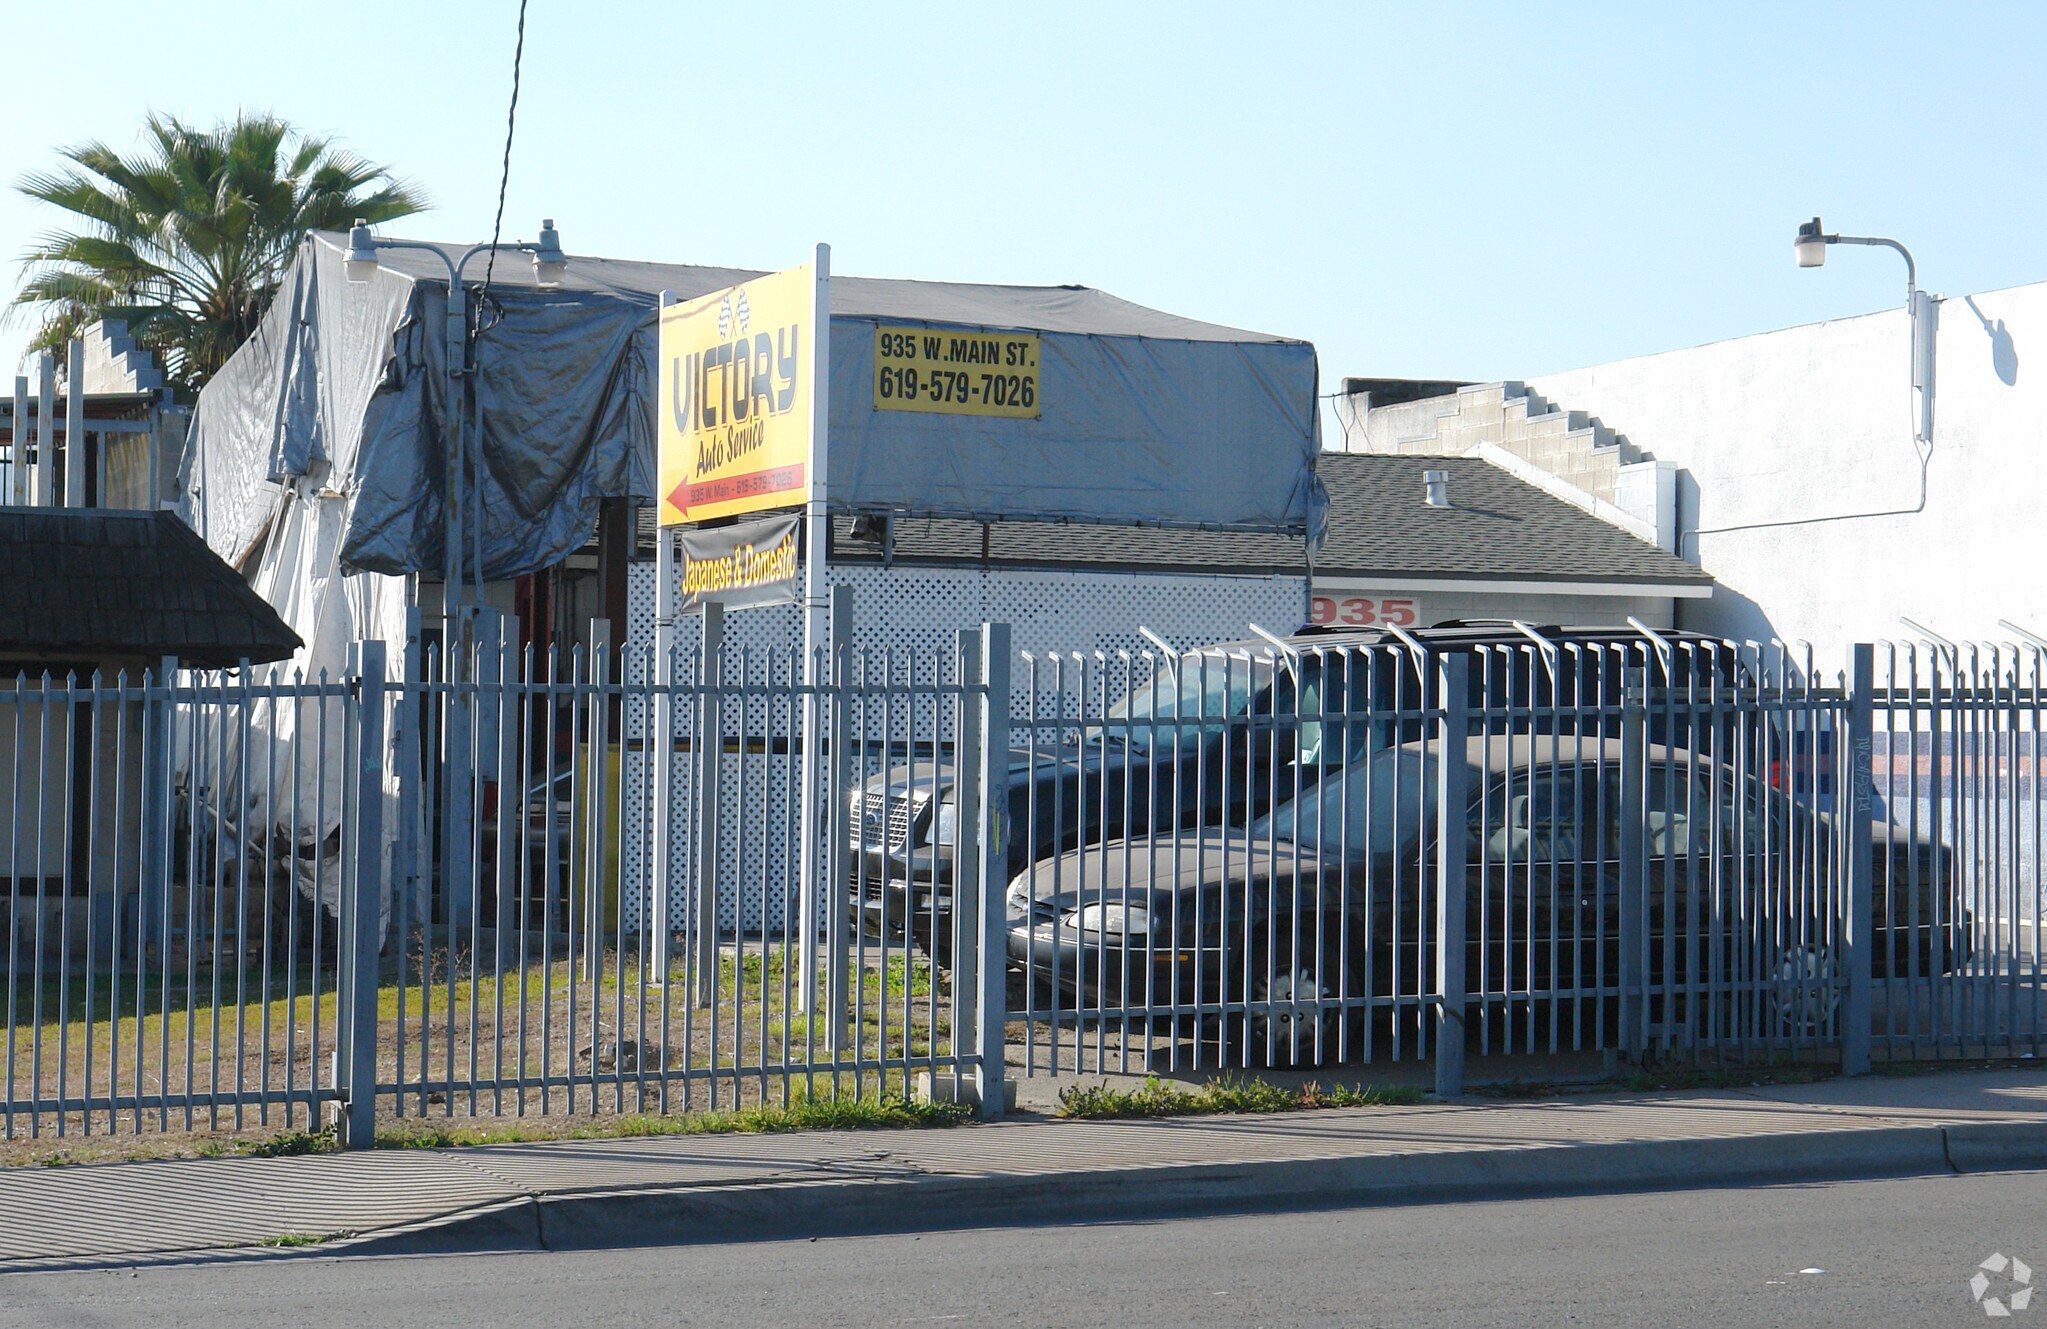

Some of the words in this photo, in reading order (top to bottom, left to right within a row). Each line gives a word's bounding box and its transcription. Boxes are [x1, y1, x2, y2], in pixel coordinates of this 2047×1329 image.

[881, 333, 917, 359] 935
[1005, 341, 1035, 367] ST.
[673, 323, 799, 436] VICTORY
[879, 366, 1035, 408] 619-579-7026
[696, 433, 724, 479] Auto
[726, 414, 765, 464] Service
[682, 552, 733, 604] Japanese
[733, 543, 743, 589] &
[743, 533, 797, 589] Domestic
[1311, 597, 1416, 626] 935
